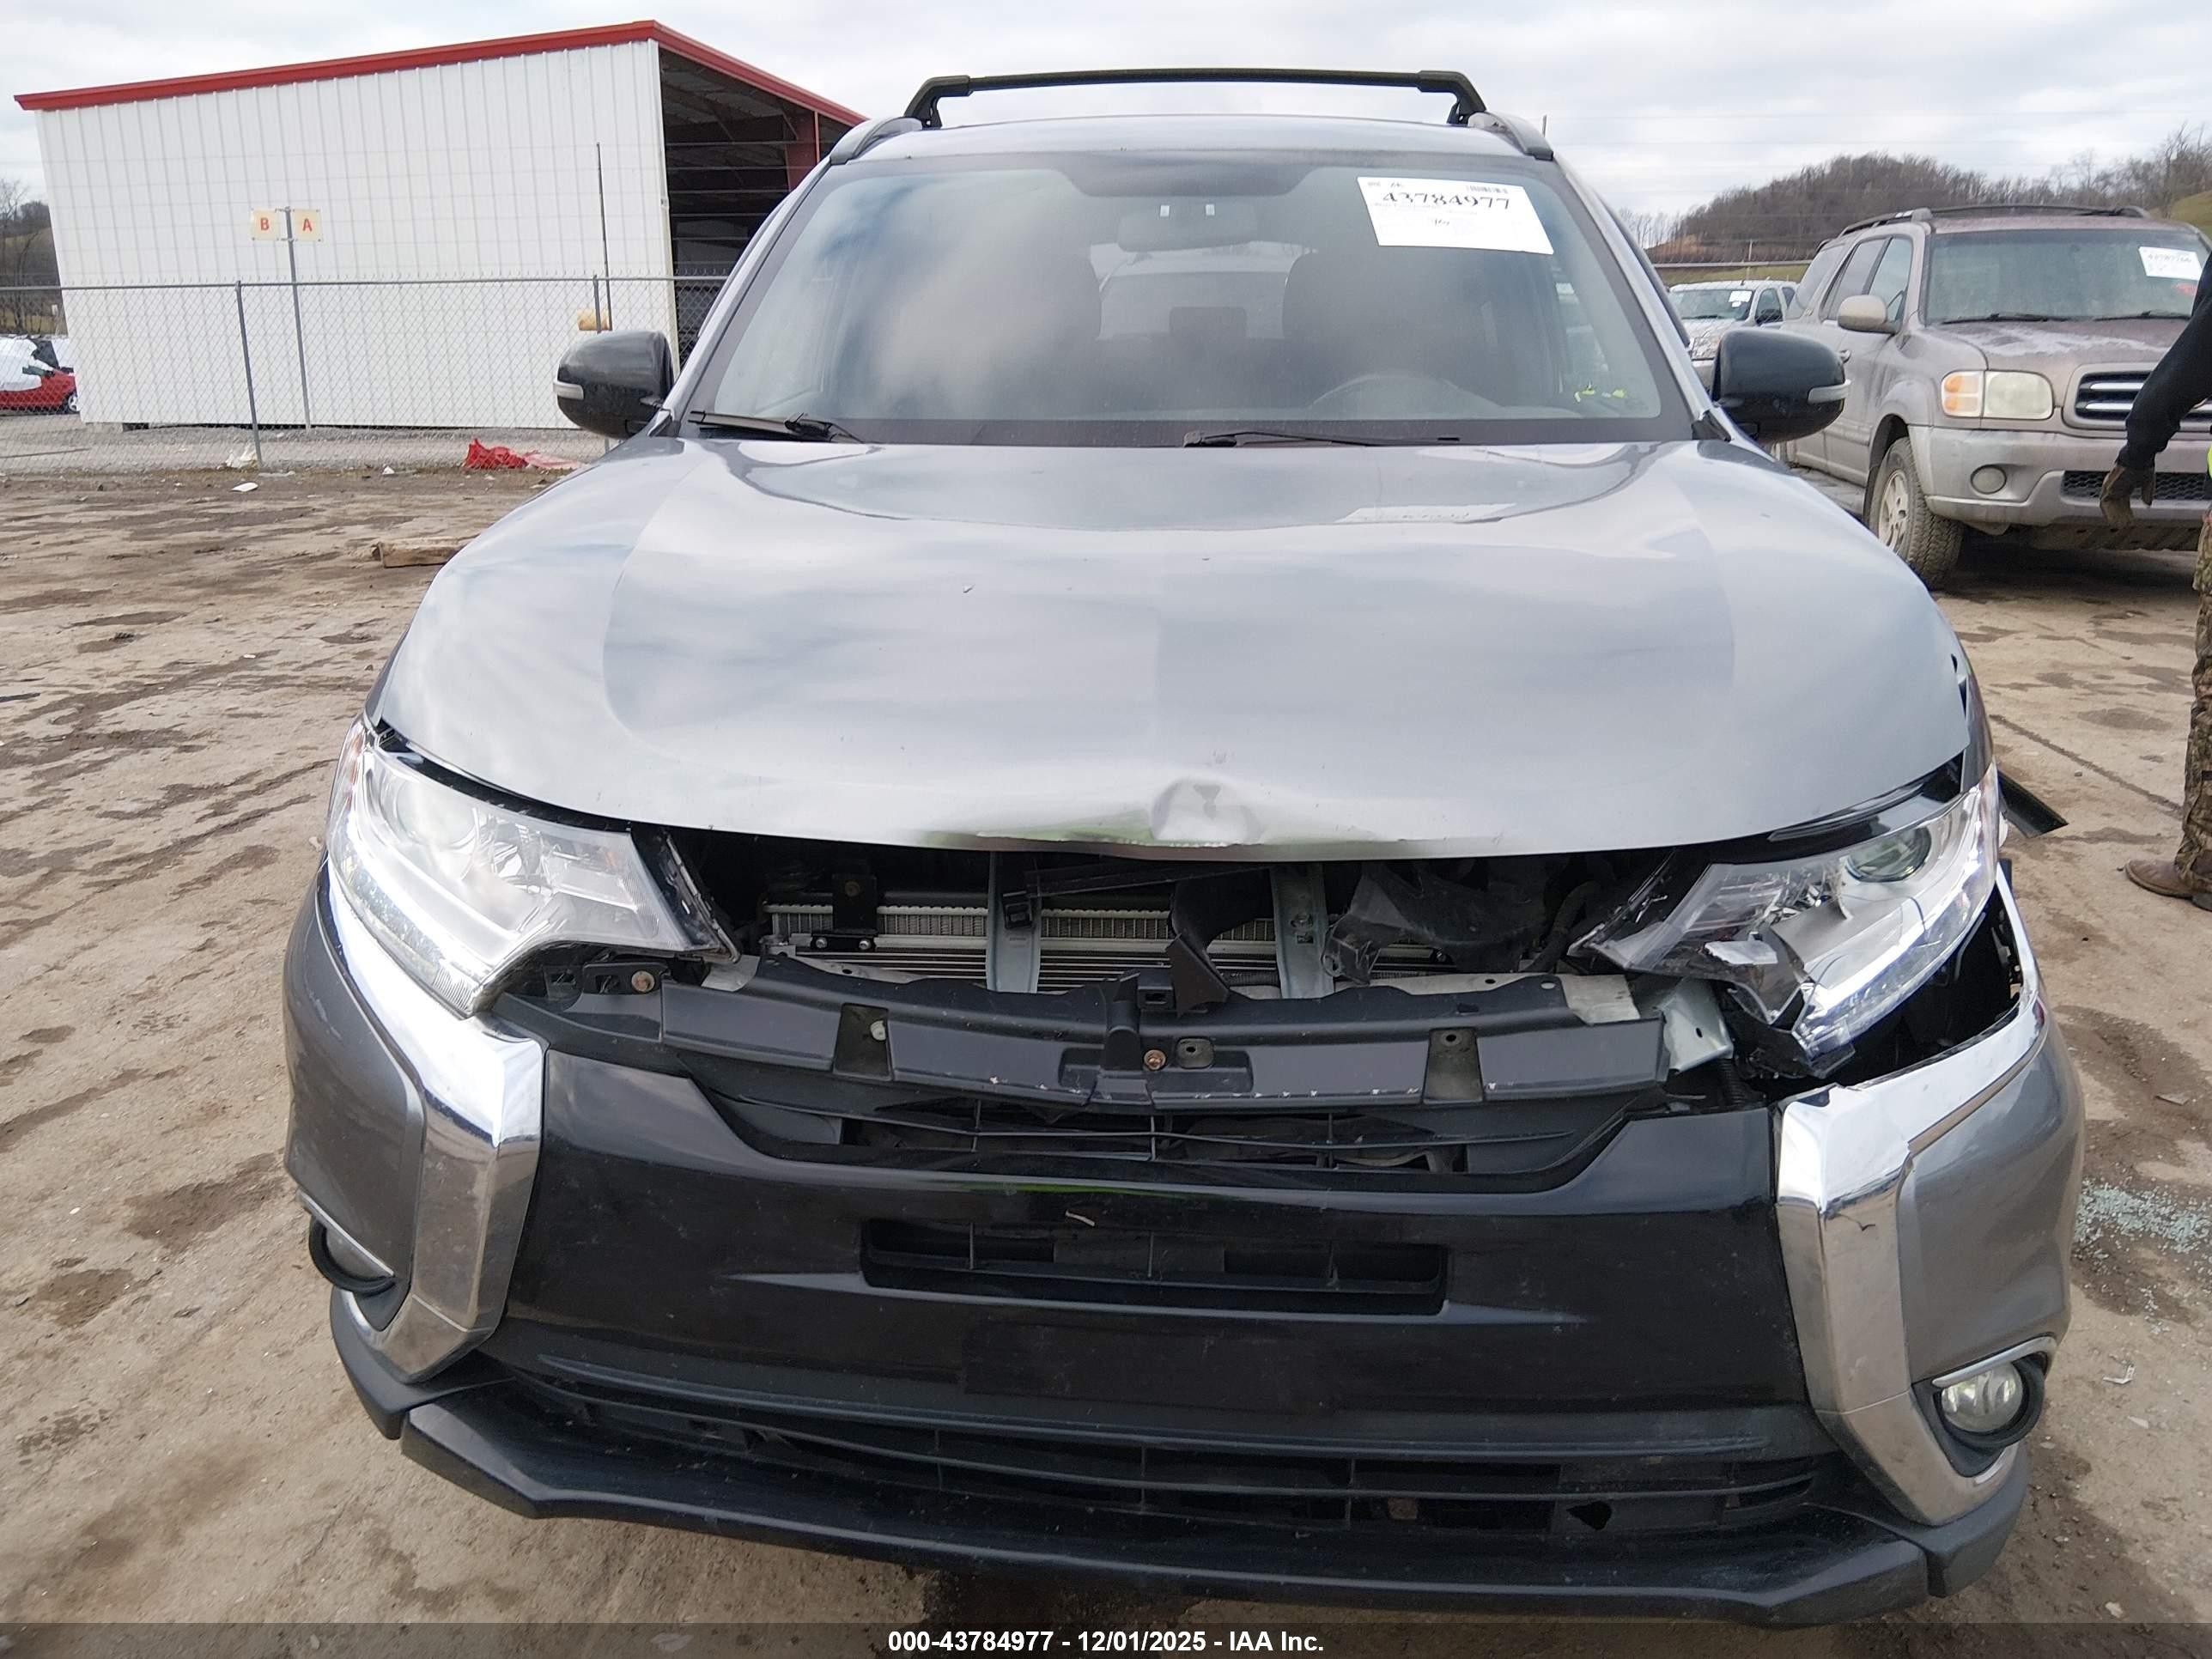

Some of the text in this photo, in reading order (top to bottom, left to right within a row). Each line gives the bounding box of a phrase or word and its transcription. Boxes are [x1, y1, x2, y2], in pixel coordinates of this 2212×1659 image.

[1382, 191, 1510, 210] 43784977
[260, 217, 270, 231] B
[302, 218, 313, 232] A
